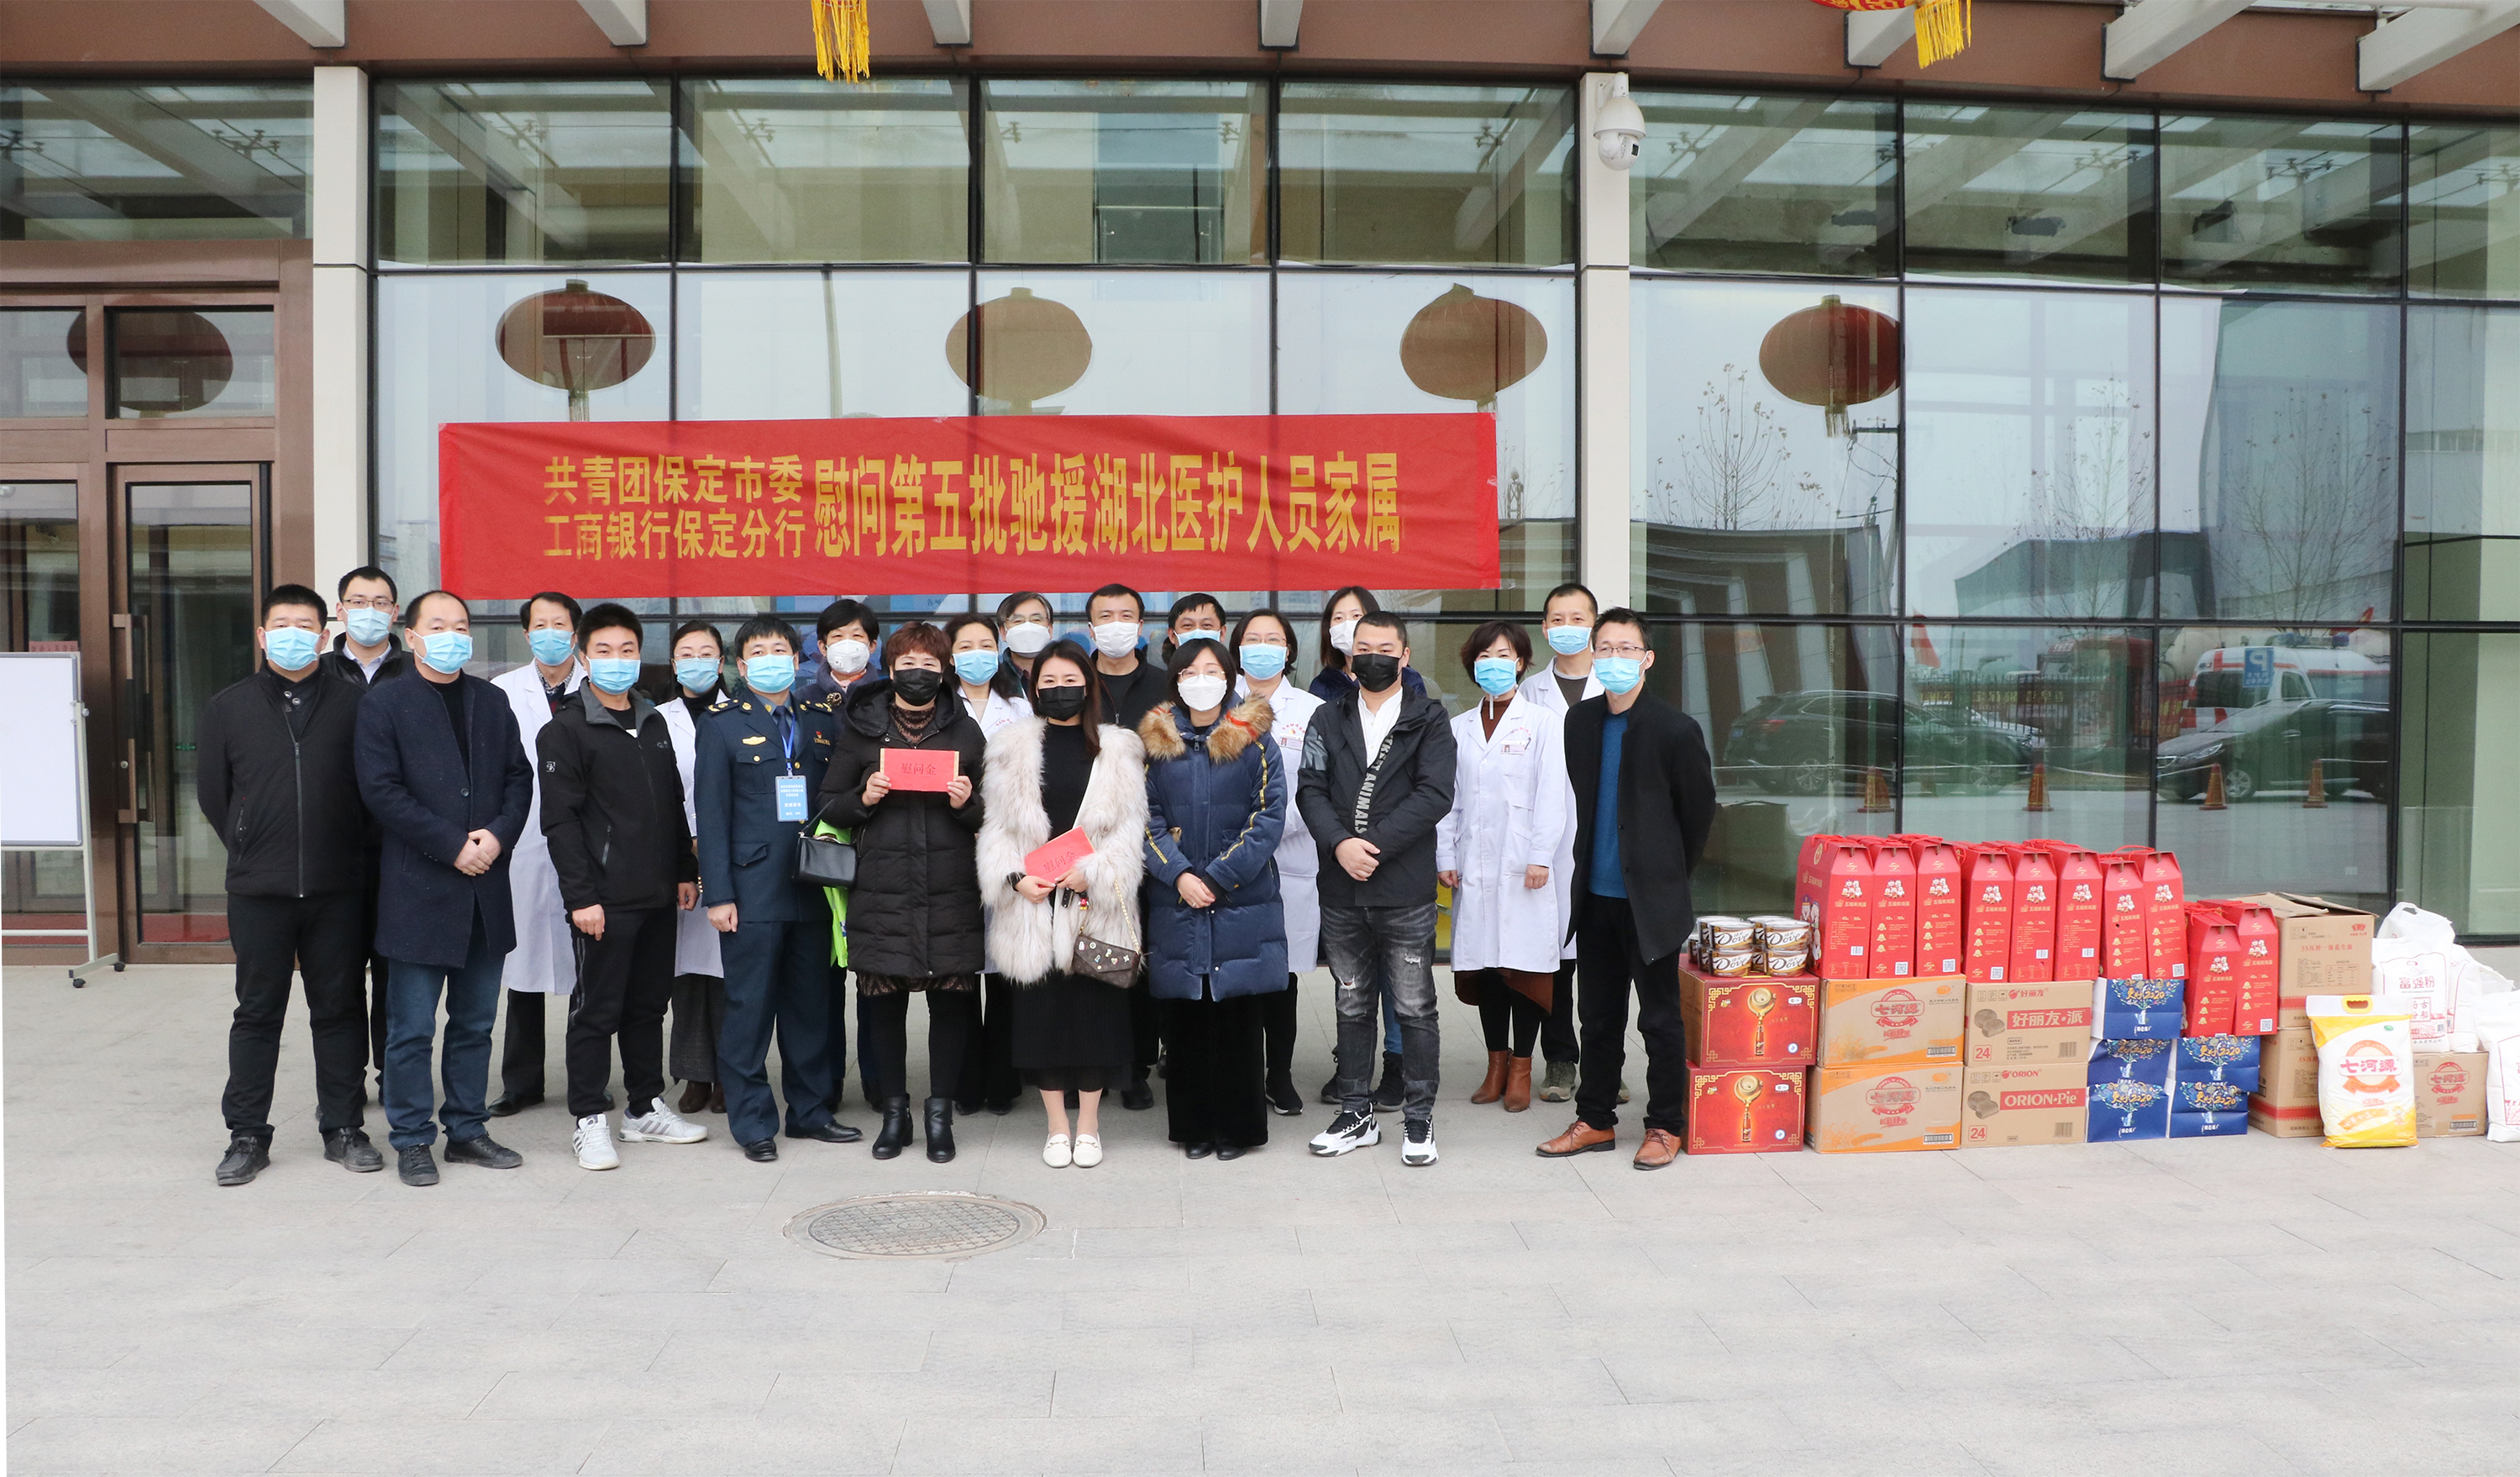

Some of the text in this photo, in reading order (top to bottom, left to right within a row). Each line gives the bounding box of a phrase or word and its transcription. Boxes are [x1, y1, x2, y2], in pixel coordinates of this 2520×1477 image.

[543, 454, 803, 506] 共青团保定市委
[814, 450, 1402, 558] 慰问第五批驰援湖北医护人员家属
[543, 507, 806, 560] 工商银行保定分行
[901, 763, 937, 775] 慰问金
[1354, 772, 1377, 834] ANIMALS
[1043, 851, 1075, 874] 慰问金
[1712, 932, 1750, 945] Dove
[1765, 932, 1802, 946] Dove
[1712, 957, 1749, 970] Dove
[1767, 957, 1803, 971] Dove
[2399, 976, 2435, 990] 富强粉
[1975, 1048, 1991, 1059] 24
[2340, 1059, 2397, 1074] 七河源
[2430, 1075, 2465, 1084] 七河源
[1970, 1127, 1986, 1139] 24
